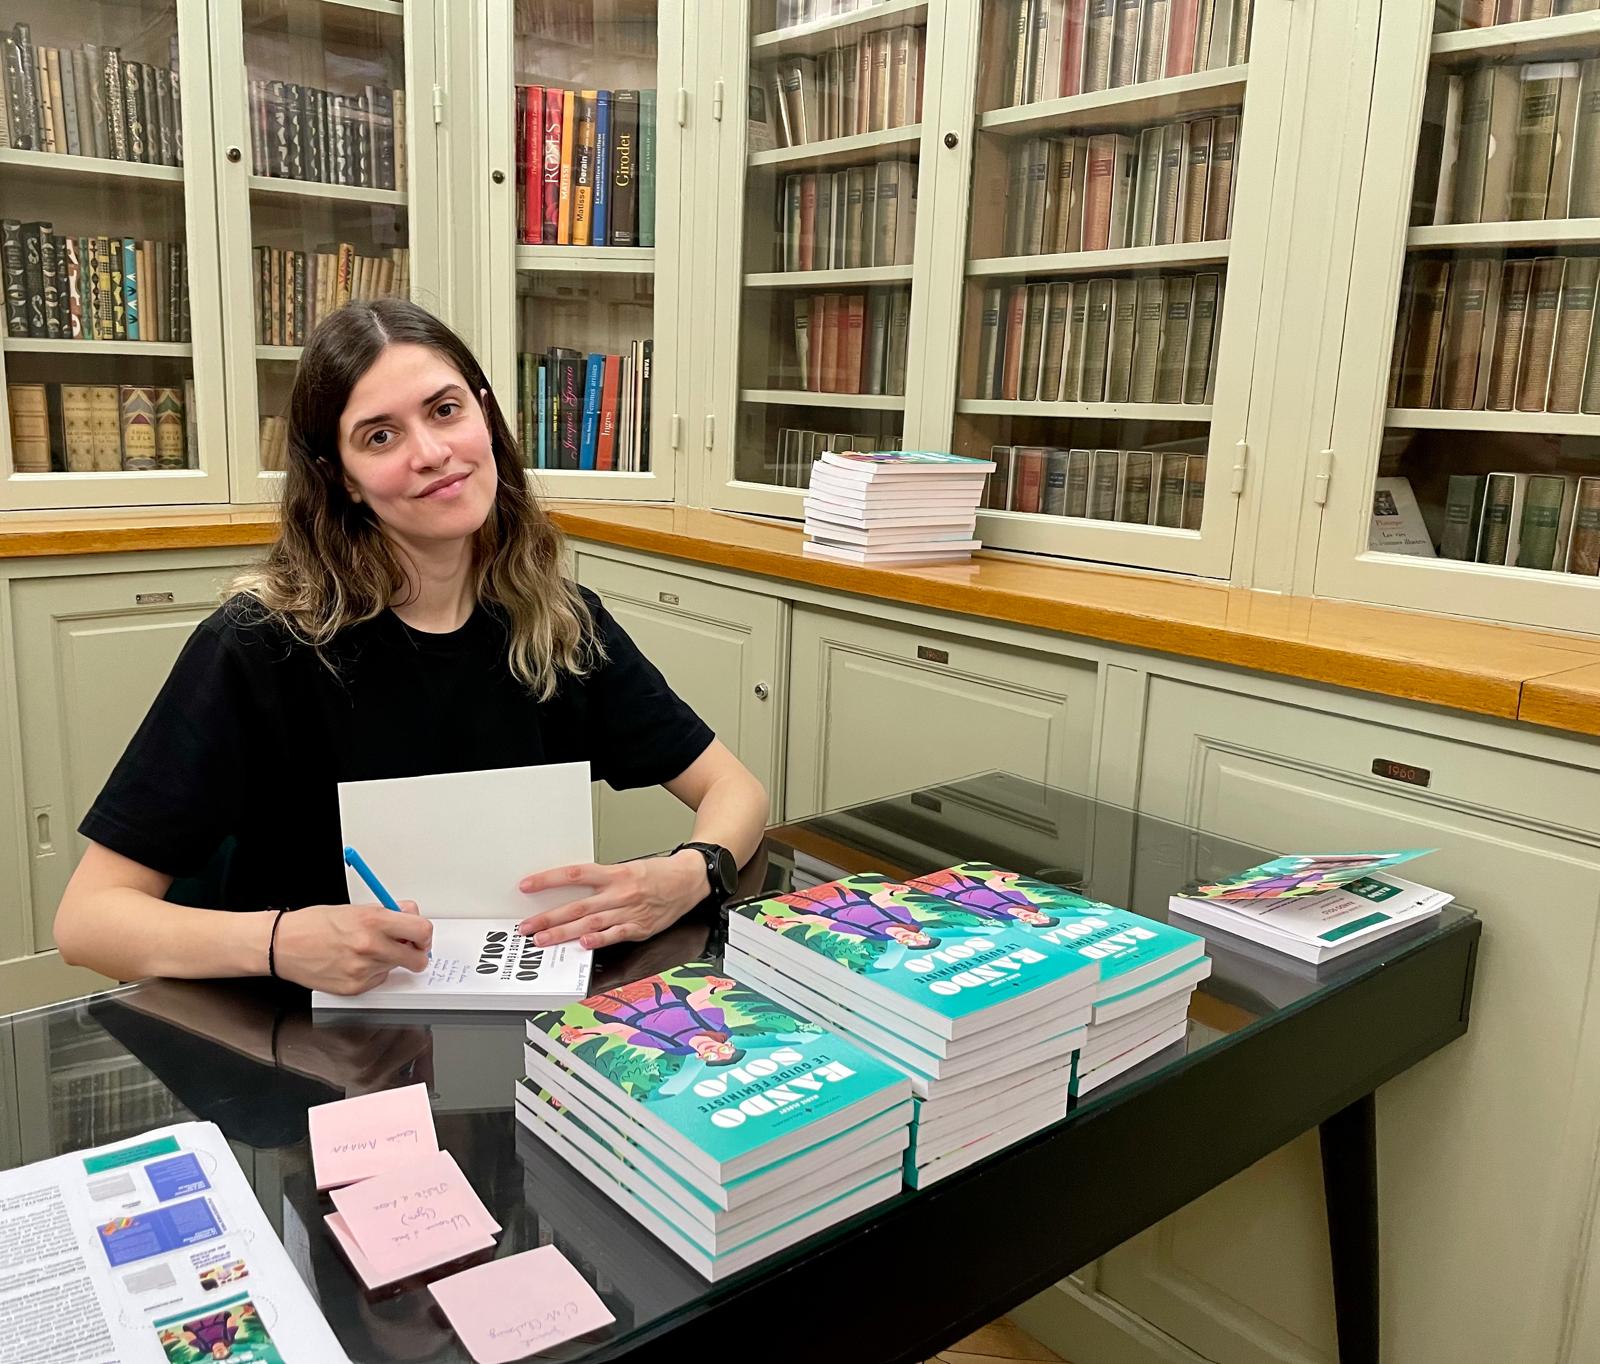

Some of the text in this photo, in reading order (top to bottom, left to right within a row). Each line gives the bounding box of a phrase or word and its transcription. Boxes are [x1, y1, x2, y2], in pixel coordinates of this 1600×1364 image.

[544, 123, 560, 183] ROSES
[579, 155, 588, 184] Derain
[615, 134, 631, 187] Girodet
[577, 189, 585, 222] Matisse
[561, 365, 578, 460] Jacques Garcia
[586, 388, 596, 415] Femmes
[601, 411, 613, 436] Ingres
[1388, 764, 1416, 780] 1960
[1004, 943, 1021, 951] LE
[1039, 916, 1109, 945] SOL
[1064, 933, 1100, 950] FÉMIN
[1078, 926, 1159, 960] RAND
[476, 931, 508, 975] SOLO
[500, 935, 521, 980] GUIDE FÉMINISTE
[904, 937, 996, 973] SOLO
[975, 948, 1006, 963] GUIDE
[914, 960, 974, 984] FÉMINISTE
[929, 947, 1049, 996] RANDO
[693, 1047, 804, 1098] SOLO
[773, 1063, 813, 1083] GUIDE
[815, 1054, 831, 1065] LE
[697, 1080, 771, 1114] FÉMINISTE
[710, 1060, 857, 1129] RANDO
